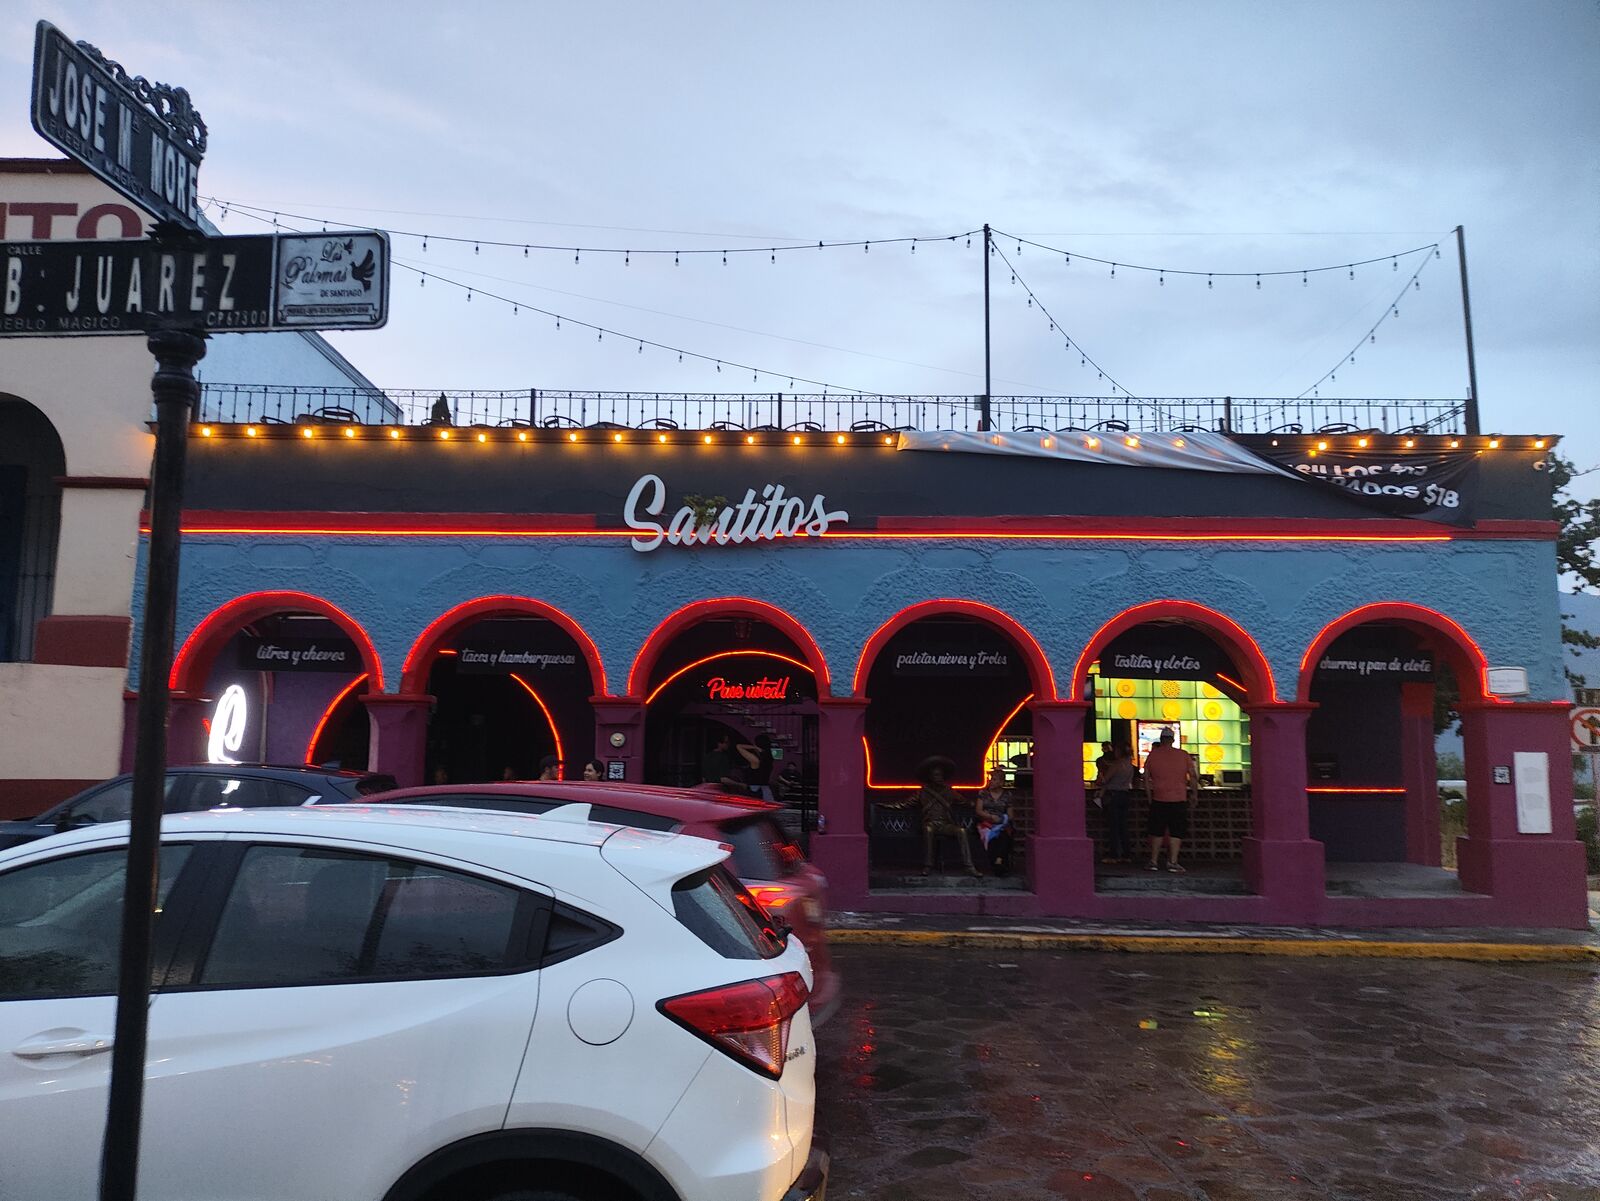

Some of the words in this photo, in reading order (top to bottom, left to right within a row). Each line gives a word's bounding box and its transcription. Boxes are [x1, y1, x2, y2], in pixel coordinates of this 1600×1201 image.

[49, 50, 106, 154] JOSE
[0, 202, 142, 240] TO
[7, 246, 42, 256] CALLE
[66, 254, 236, 314] JUAREZ
[58, 316, 120, 330] MAGICO
[1423, 483, 1460, 508] $18
[623, 474, 848, 552] Santitos
[498, 650, 576, 670] hamburguesas
